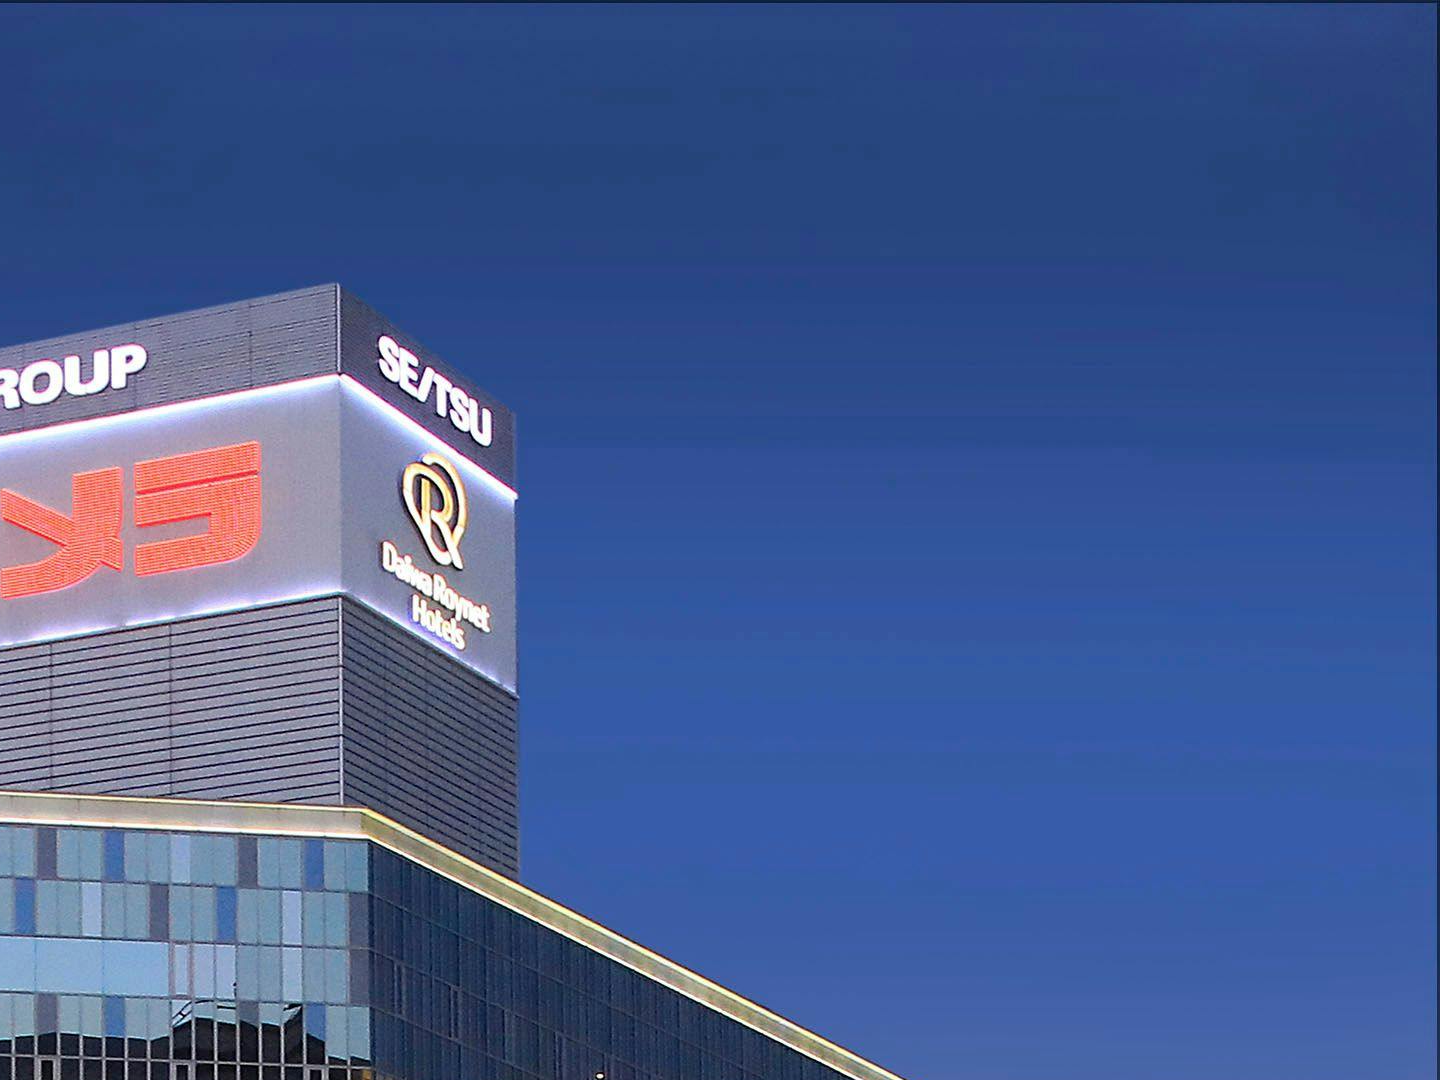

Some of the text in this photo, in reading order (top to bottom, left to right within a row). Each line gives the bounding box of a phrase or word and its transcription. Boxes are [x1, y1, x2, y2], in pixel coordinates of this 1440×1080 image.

[382, 541, 491, 633] Daiwa Roynet
[412, 593, 466, 650] Hotels
